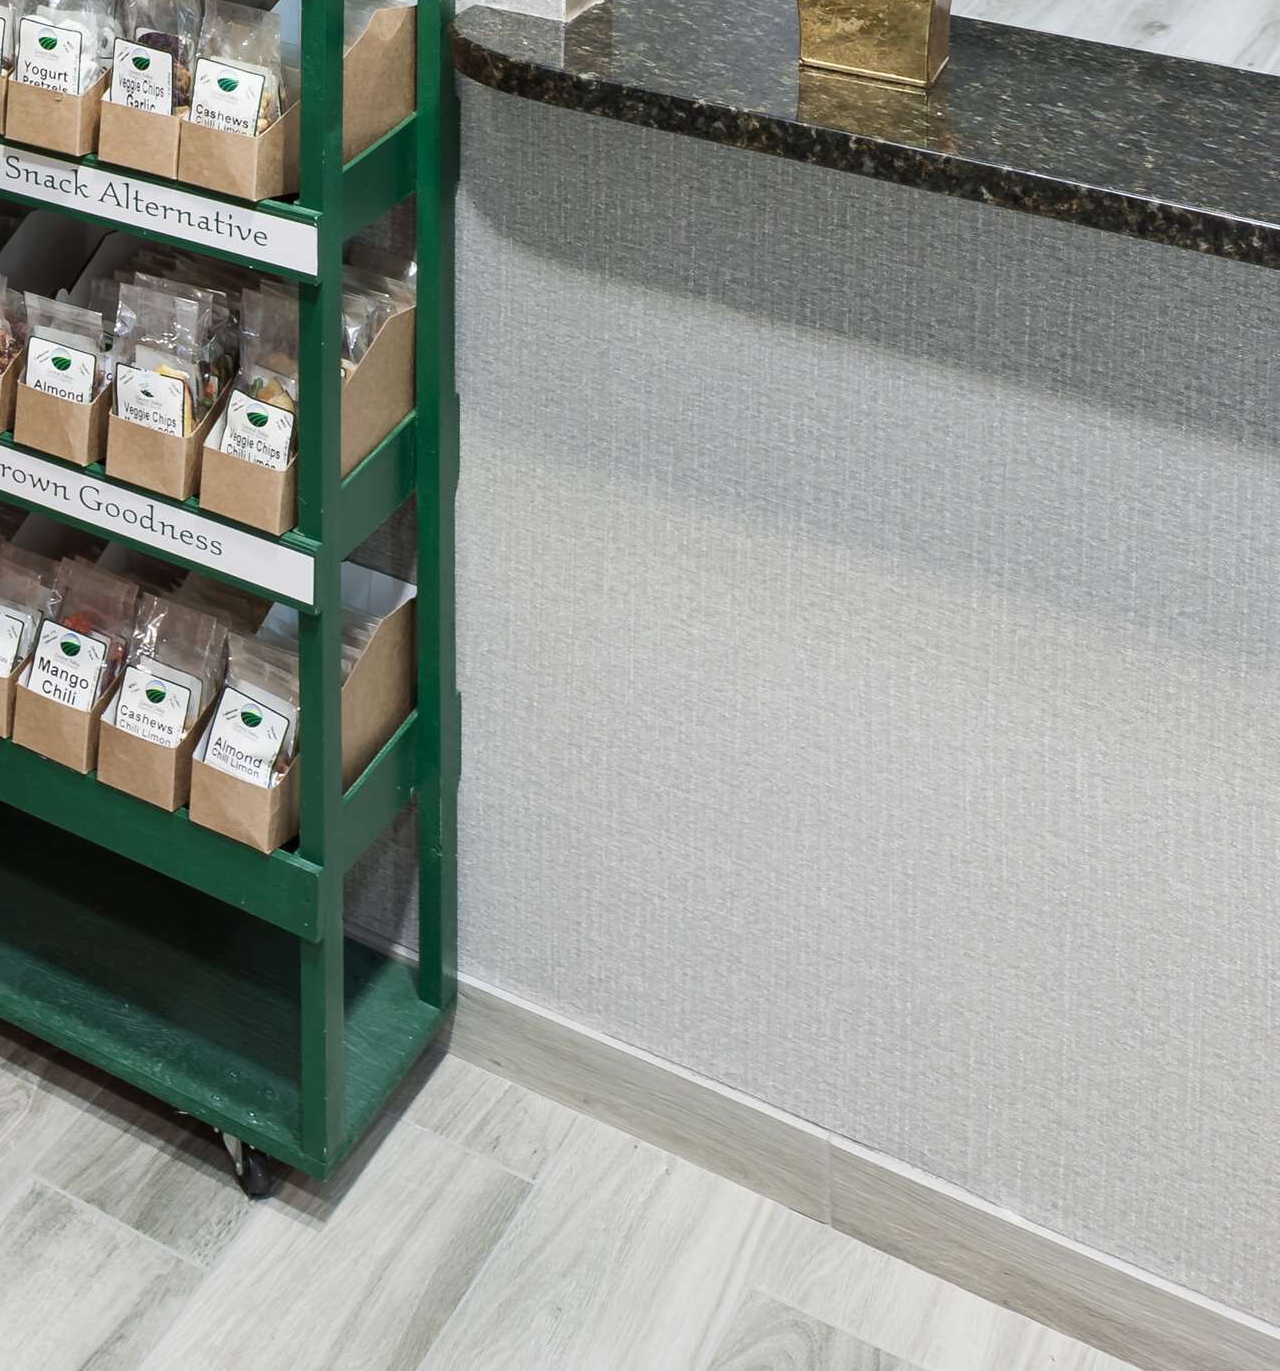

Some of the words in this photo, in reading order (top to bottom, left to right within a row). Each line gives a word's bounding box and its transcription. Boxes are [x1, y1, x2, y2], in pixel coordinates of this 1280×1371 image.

[24, 60, 68, 83] Yogurt
[118, 77, 141, 93] Veggie
[142, 78, 165, 98] Chips
[196, 103, 249, 129] Cashews
[5, 155, 89, 204] Snack
[97, 181, 268, 247] Alternative
[34, 379, 84, 403] Almond
[124, 401, 150, 421] Veggie
[152, 410, 177, 428] Chips
[229, 431, 255, 449] Veggie
[256, 439, 280, 460] Chips
[79, 485, 223, 556] Goodness
[37, 656, 89, 690] Mango
[42, 679, 77, 706] Chili
[120, 704, 174, 735] Cashews
[211, 747, 229, 767] Chili
[230, 756, 259, 779] Limon
[213, 736, 262, 769] Almond
